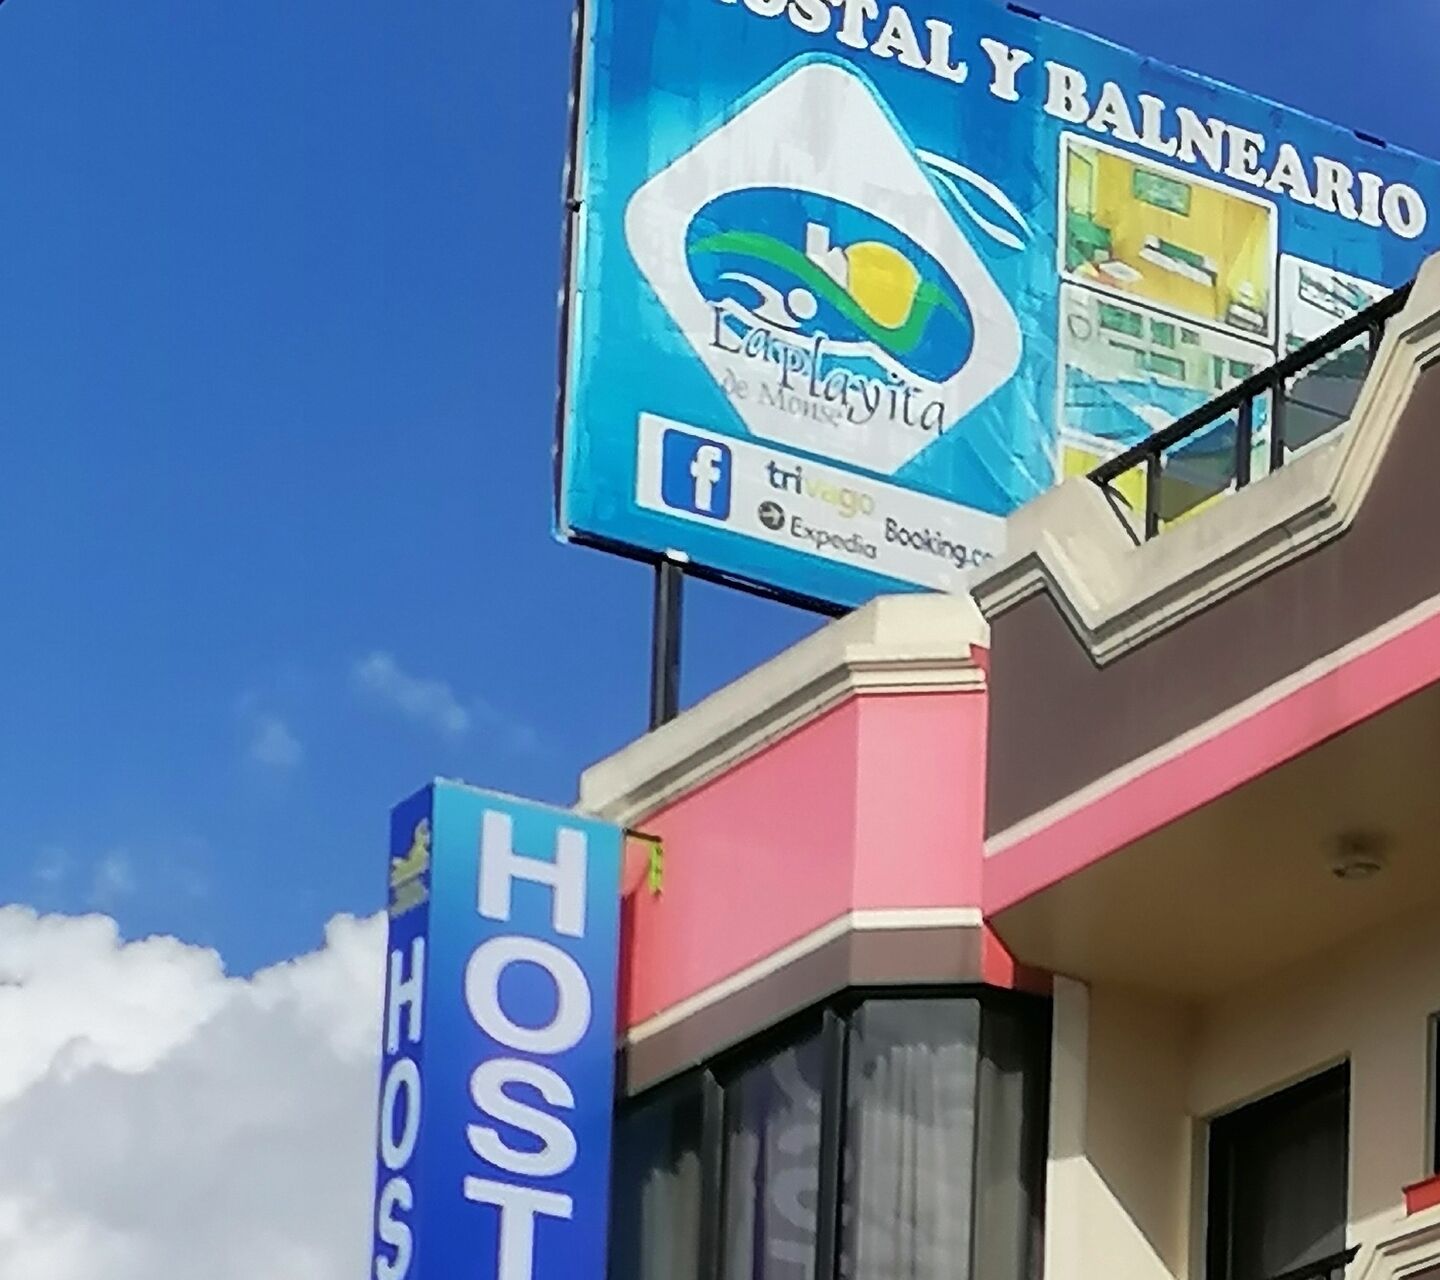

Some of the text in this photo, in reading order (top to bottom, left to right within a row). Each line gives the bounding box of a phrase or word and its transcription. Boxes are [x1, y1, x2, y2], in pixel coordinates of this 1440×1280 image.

[725, 0, 1430, 241] STAL Y BALNEARIO
[766, 461, 876, 518] trivago
[791, 516, 878, 560] Expedia
